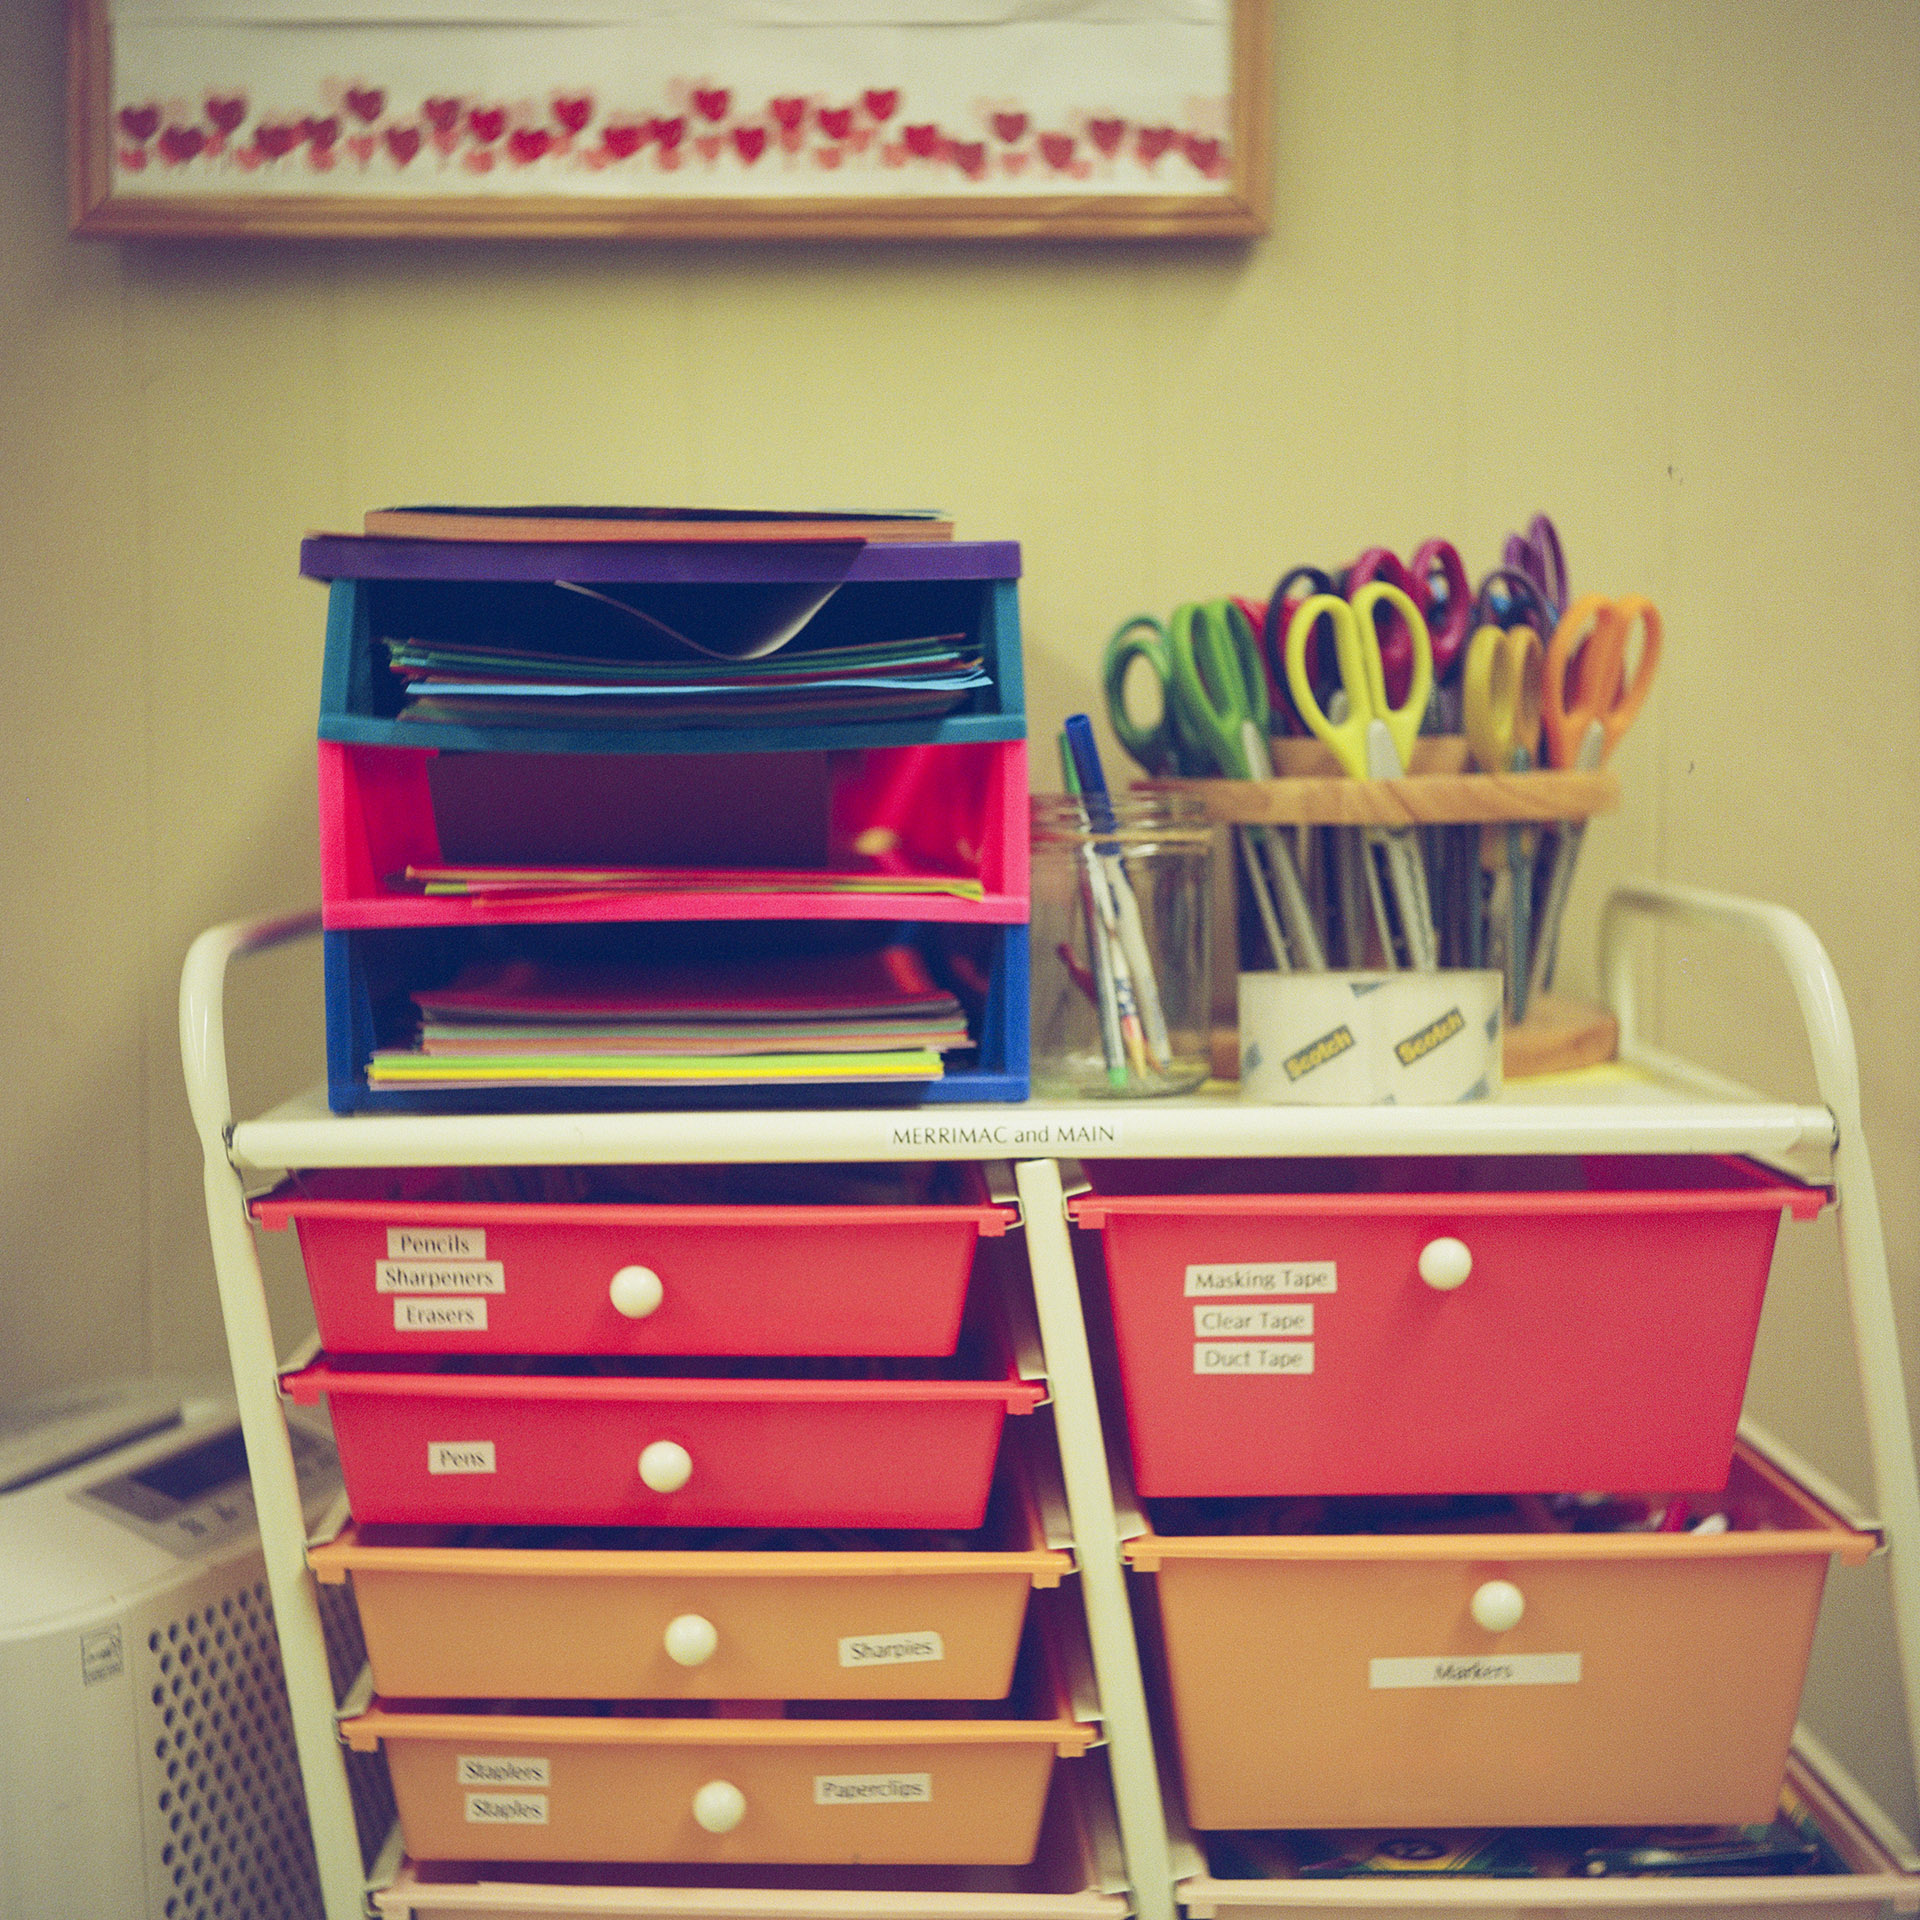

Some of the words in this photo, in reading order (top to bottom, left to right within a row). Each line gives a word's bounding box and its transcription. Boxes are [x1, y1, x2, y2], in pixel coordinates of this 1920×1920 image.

[1398, 1011, 1463, 1064] Scotch
[1285, 1028, 1353, 1080] Scotch
[892, 1127, 1009, 1145] MERRIMAC
[1014, 1126, 1049, 1143] and
[1057, 1126, 1115, 1143] MAIN
[400, 1233, 470, 1253] Pencils
[385, 1266, 495, 1289] Sharpeners
[1195, 1270, 1276, 1291] Masking
[1282, 1268, 1328, 1288] Tape
[406, 1304, 476, 1325] Erasers
[1201, 1311, 1252, 1331] Clear
[1260, 1310, 1305, 1331] Tape
[1204, 1348, 1251, 1368] Duct
[1258, 1348, 1304, 1369] Tape
[439, 1447, 488, 1469] Pens
[850, 1639, 934, 1662] Sharpies
[464, 1760, 544, 1781] Staplers
[822, 1778, 925, 1800] Paperclips
[472, 1798, 544, 1818] Staples
